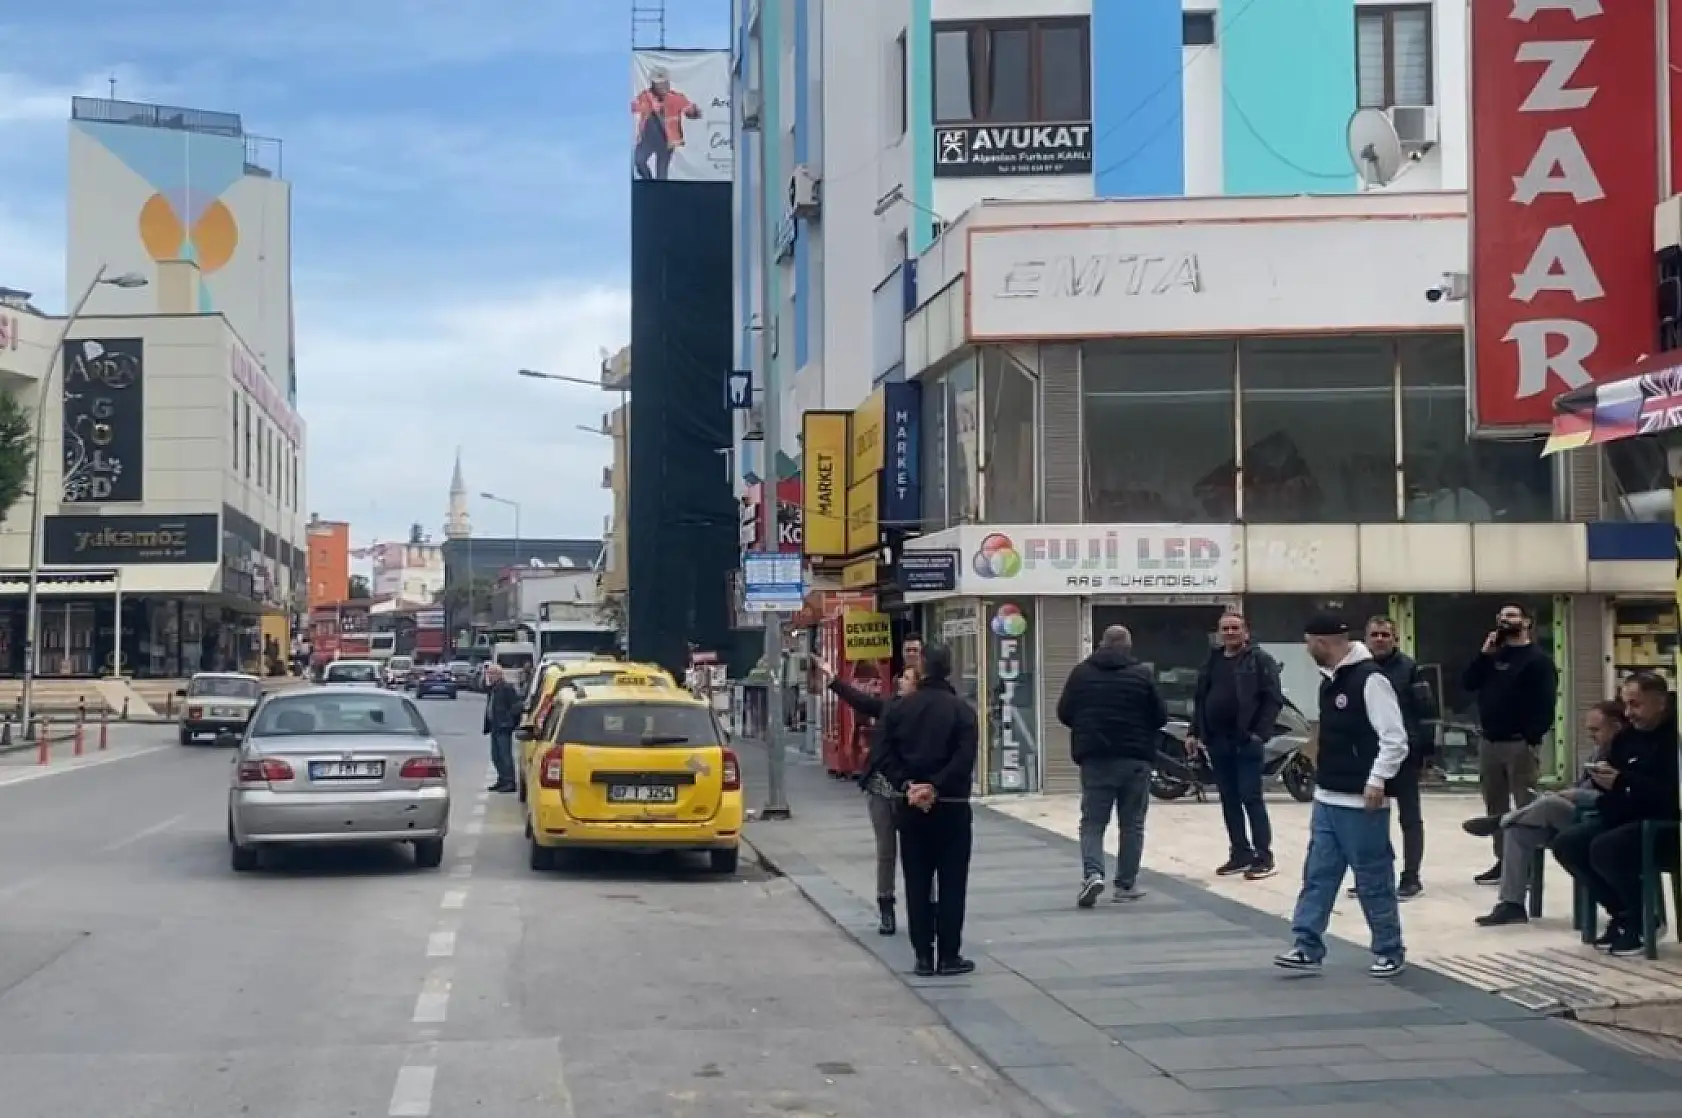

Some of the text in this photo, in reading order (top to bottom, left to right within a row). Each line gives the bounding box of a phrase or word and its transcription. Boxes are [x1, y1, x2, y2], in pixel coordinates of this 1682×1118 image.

[972, 126, 1090, 150] AVUKAT
[993, 252, 1207, 299] EMTA
[91, 397, 114, 498] GOLD
[895, 410, 909, 500] MARKET
[817, 452, 835, 516] MARKET
[1137, 537, 1222, 570] LED
